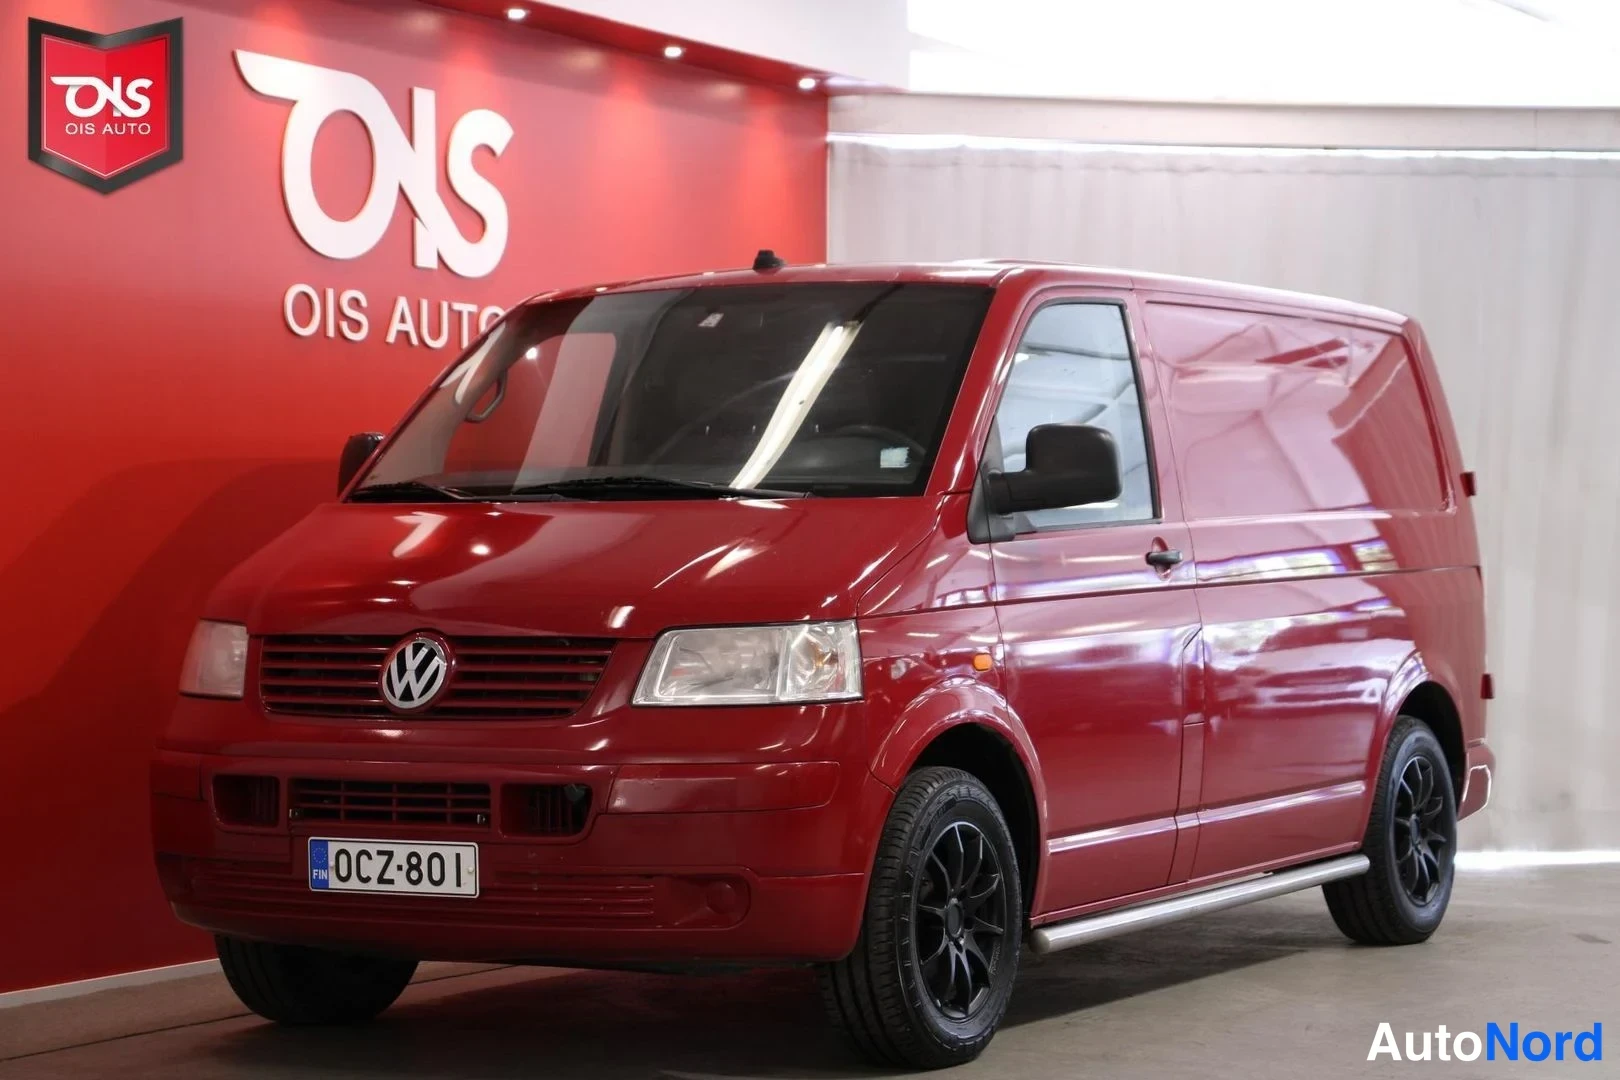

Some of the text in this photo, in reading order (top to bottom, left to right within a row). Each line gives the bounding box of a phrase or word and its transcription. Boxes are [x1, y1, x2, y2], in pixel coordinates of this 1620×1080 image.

[284, 283, 369, 341] OIS
[312, 868, 328, 880] FIN
[334, 848, 462, 888] OCZ-801
